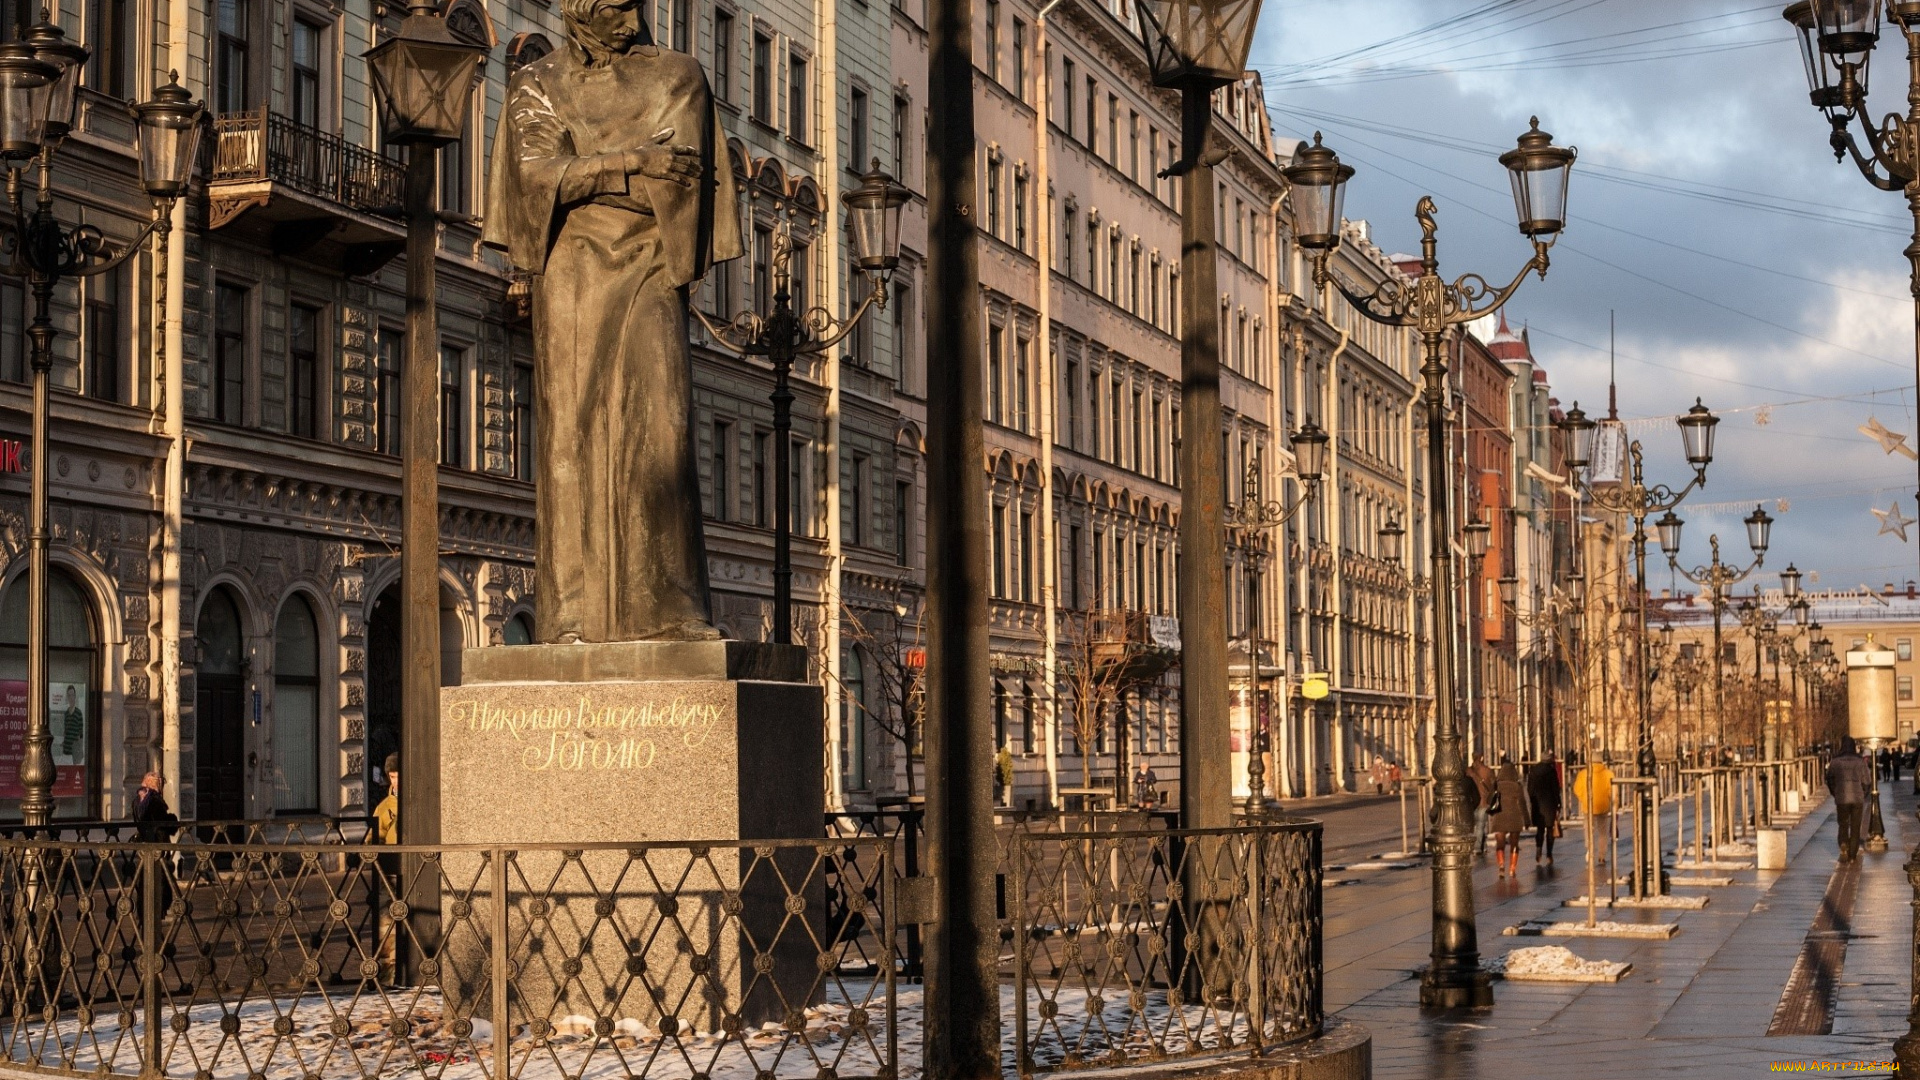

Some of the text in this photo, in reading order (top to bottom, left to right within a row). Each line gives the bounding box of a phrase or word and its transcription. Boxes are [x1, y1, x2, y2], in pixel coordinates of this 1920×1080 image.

[0, 439, 22, 473] К
[449, 696, 726, 748] Николаю Васильевичу
[522, 731, 656, 771] Гоголю
